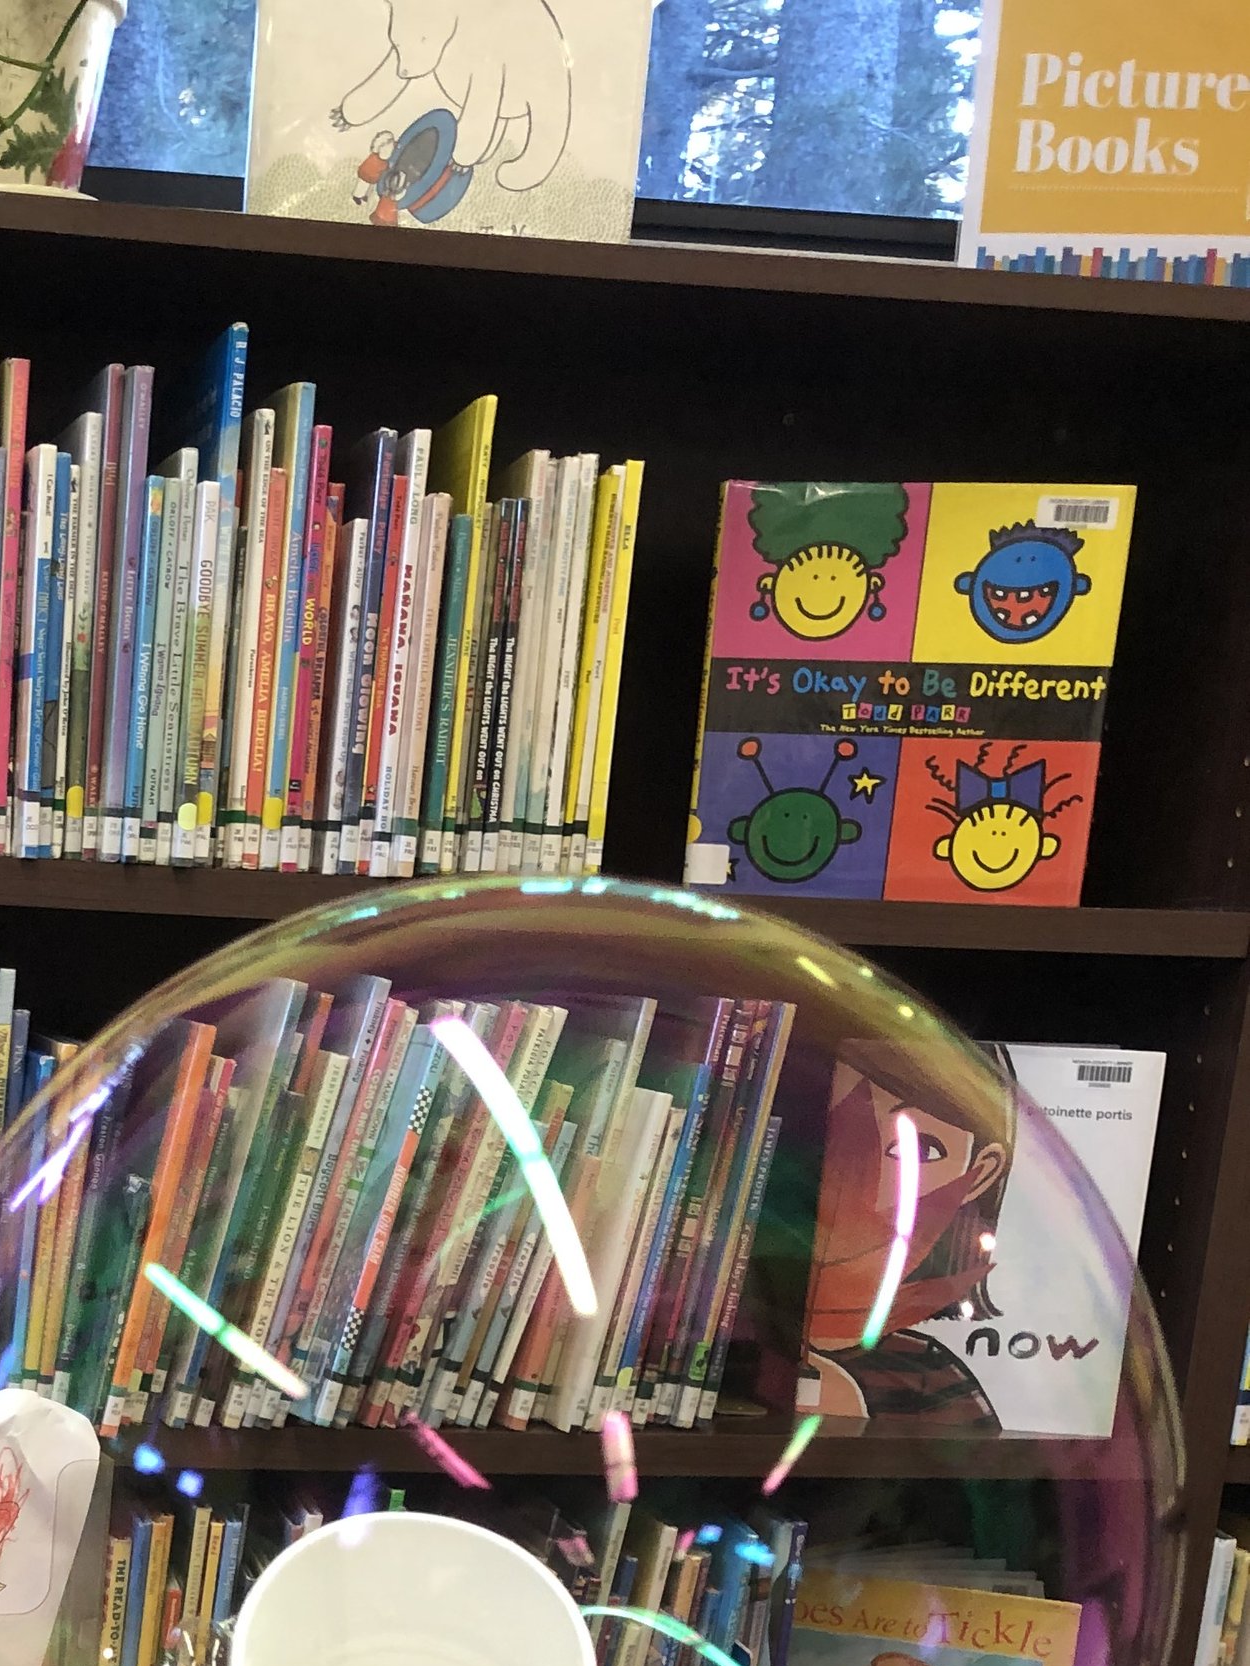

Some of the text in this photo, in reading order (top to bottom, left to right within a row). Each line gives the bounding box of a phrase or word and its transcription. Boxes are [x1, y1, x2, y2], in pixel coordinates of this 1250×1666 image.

[1020, 51, 1250, 112] Picture
[1012, 117, 1200, 176] Books
[138, 383, 147, 429] O'MALLEY
[261, 498, 267, 509] OF
[410, 448, 424, 525] PAUL LONG
[204, 500, 216, 521] PAK
[164, 502, 177, 589] ORLOFF CATROW
[623, 524, 631, 550] ELLA
[283, 530, 302, 643] Amelia Bedelia
[97, 571, 108, 655] KEVIN O'MALLEY
[302, 598, 316, 645] WORLD
[138, 652, 150, 692] Wanna
[156, 650, 165, 680] Wanna
[163, 564, 189, 792] The Brave Little Seamstress
[252, 593, 276, 772] BRAVO, AMELIA BEDELIA!
[724, 666, 1108, 703] It's Okay to Be Different
[137, 695, 148, 712] Go
[151, 683, 165, 716] Iguana
[389, 664, 402, 737] IGUANA
[436, 634, 457, 766] JENNIFER'S RABBIT
[476, 637, 498, 780] The NIGHT the LIGHTS WENT OUT on
[135, 716, 146, 749] Home
[489, 637, 515, 822] The NIGHT the LIGHTS WENT OUT on CHRISTMA
[382, 766, 392, 811] HOLIDAY
[12, 1044, 24, 1074] PENN
[1025, 1104, 1134, 1122] toinette portis
[315, 1153, 338, 1200] Boycott
[964, 1326, 1100, 1362] now
[115, 1559, 127, 1584] THE
[792, 1602, 846, 1629] oes
[851, 1609, 899, 1636] Are
[928, 1609, 1053, 1658] Tickle
